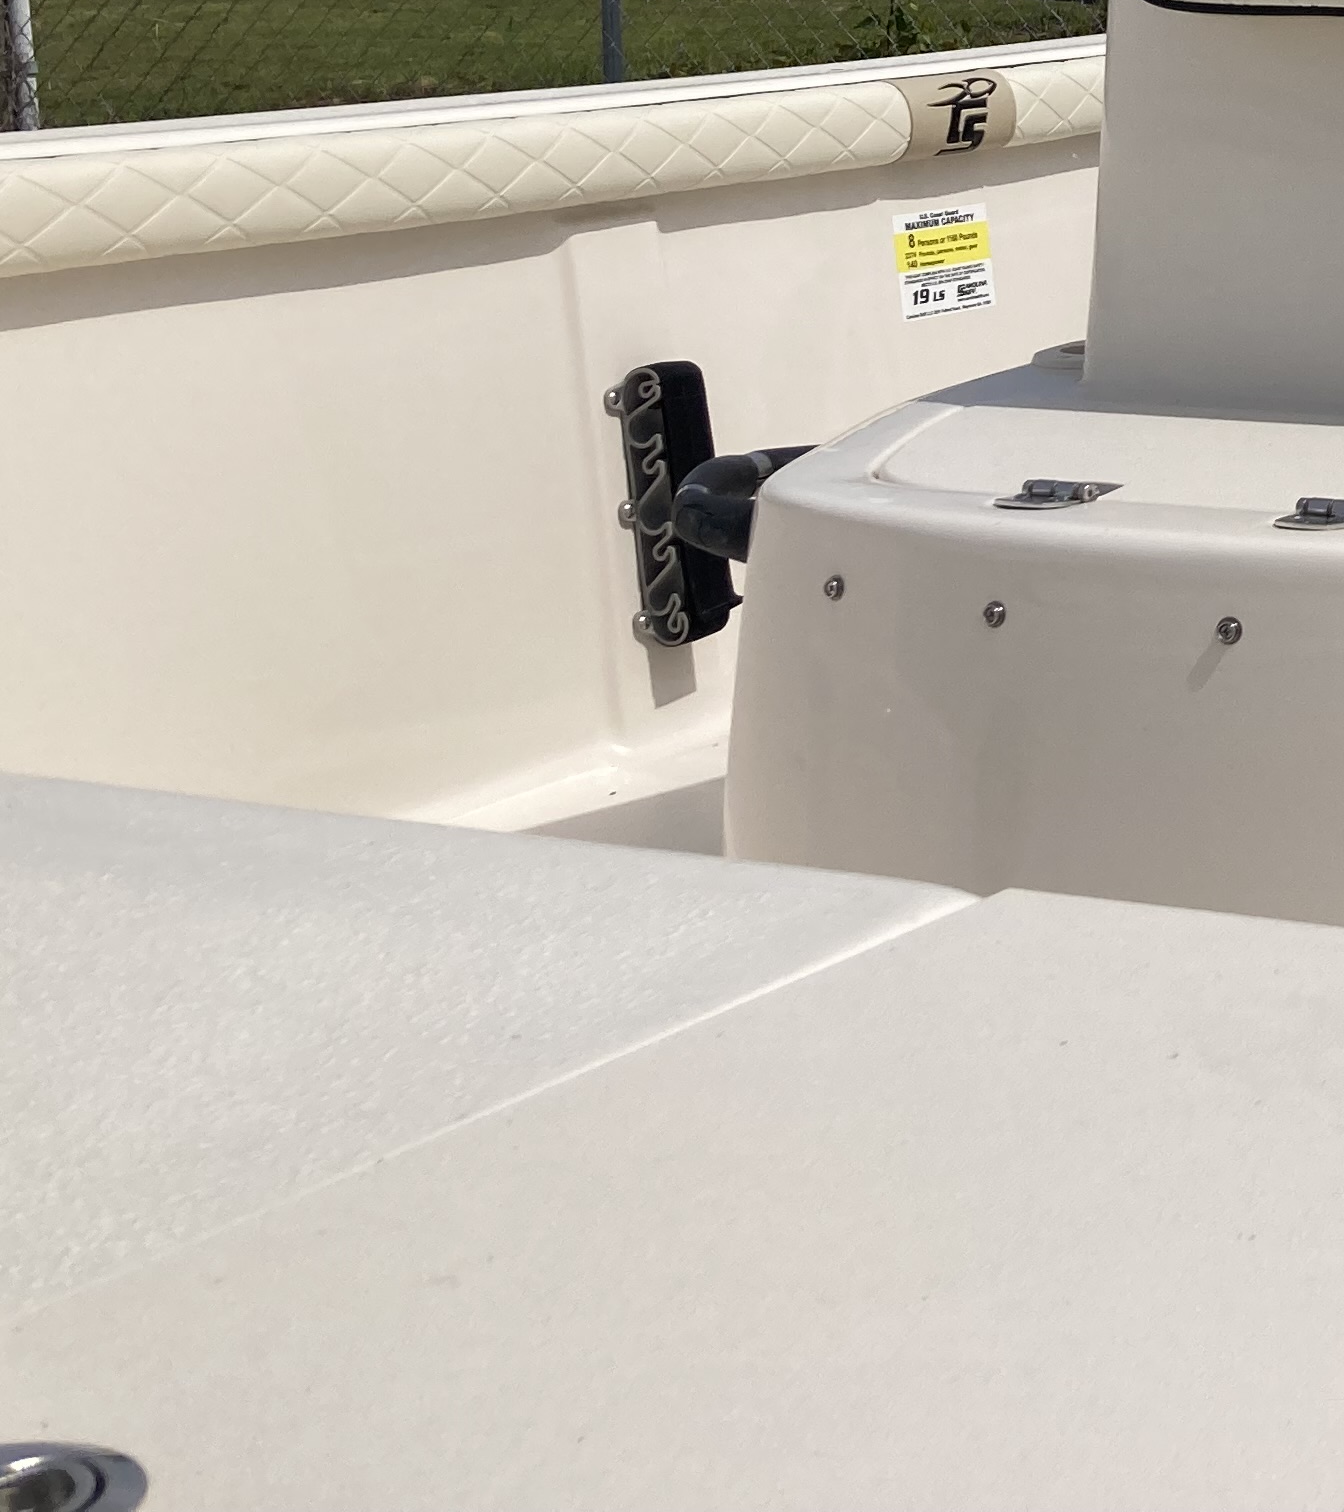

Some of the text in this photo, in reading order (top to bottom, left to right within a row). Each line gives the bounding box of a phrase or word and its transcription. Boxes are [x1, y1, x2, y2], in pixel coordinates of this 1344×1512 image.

[905, 213, 975, 230] MAXIMUM CAPACITY
[908, 234, 915, 248] 8
[913, 288, 929, 305] 19
[933, 289, 945, 302] LS
